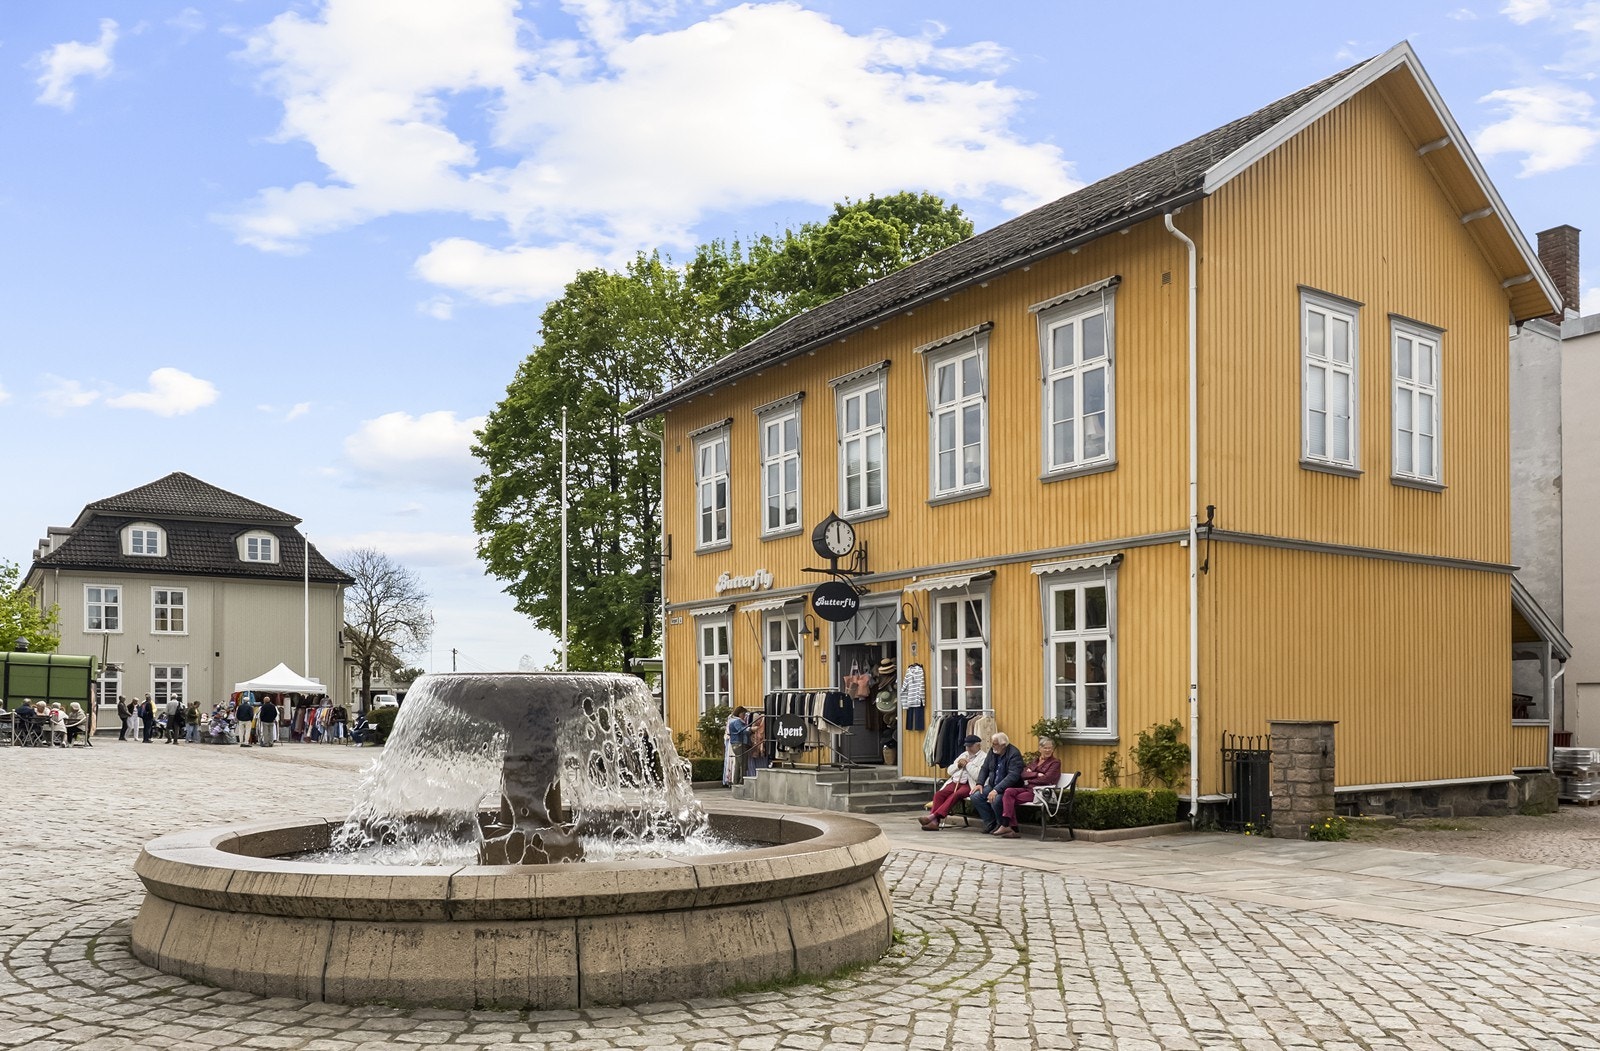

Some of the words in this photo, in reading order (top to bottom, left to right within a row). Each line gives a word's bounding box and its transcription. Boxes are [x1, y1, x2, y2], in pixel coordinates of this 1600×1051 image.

[715, 568, 774, 593] Butterfly
[815, 595, 856, 608] Butterfly
[777, 721, 803, 739] Åpent
